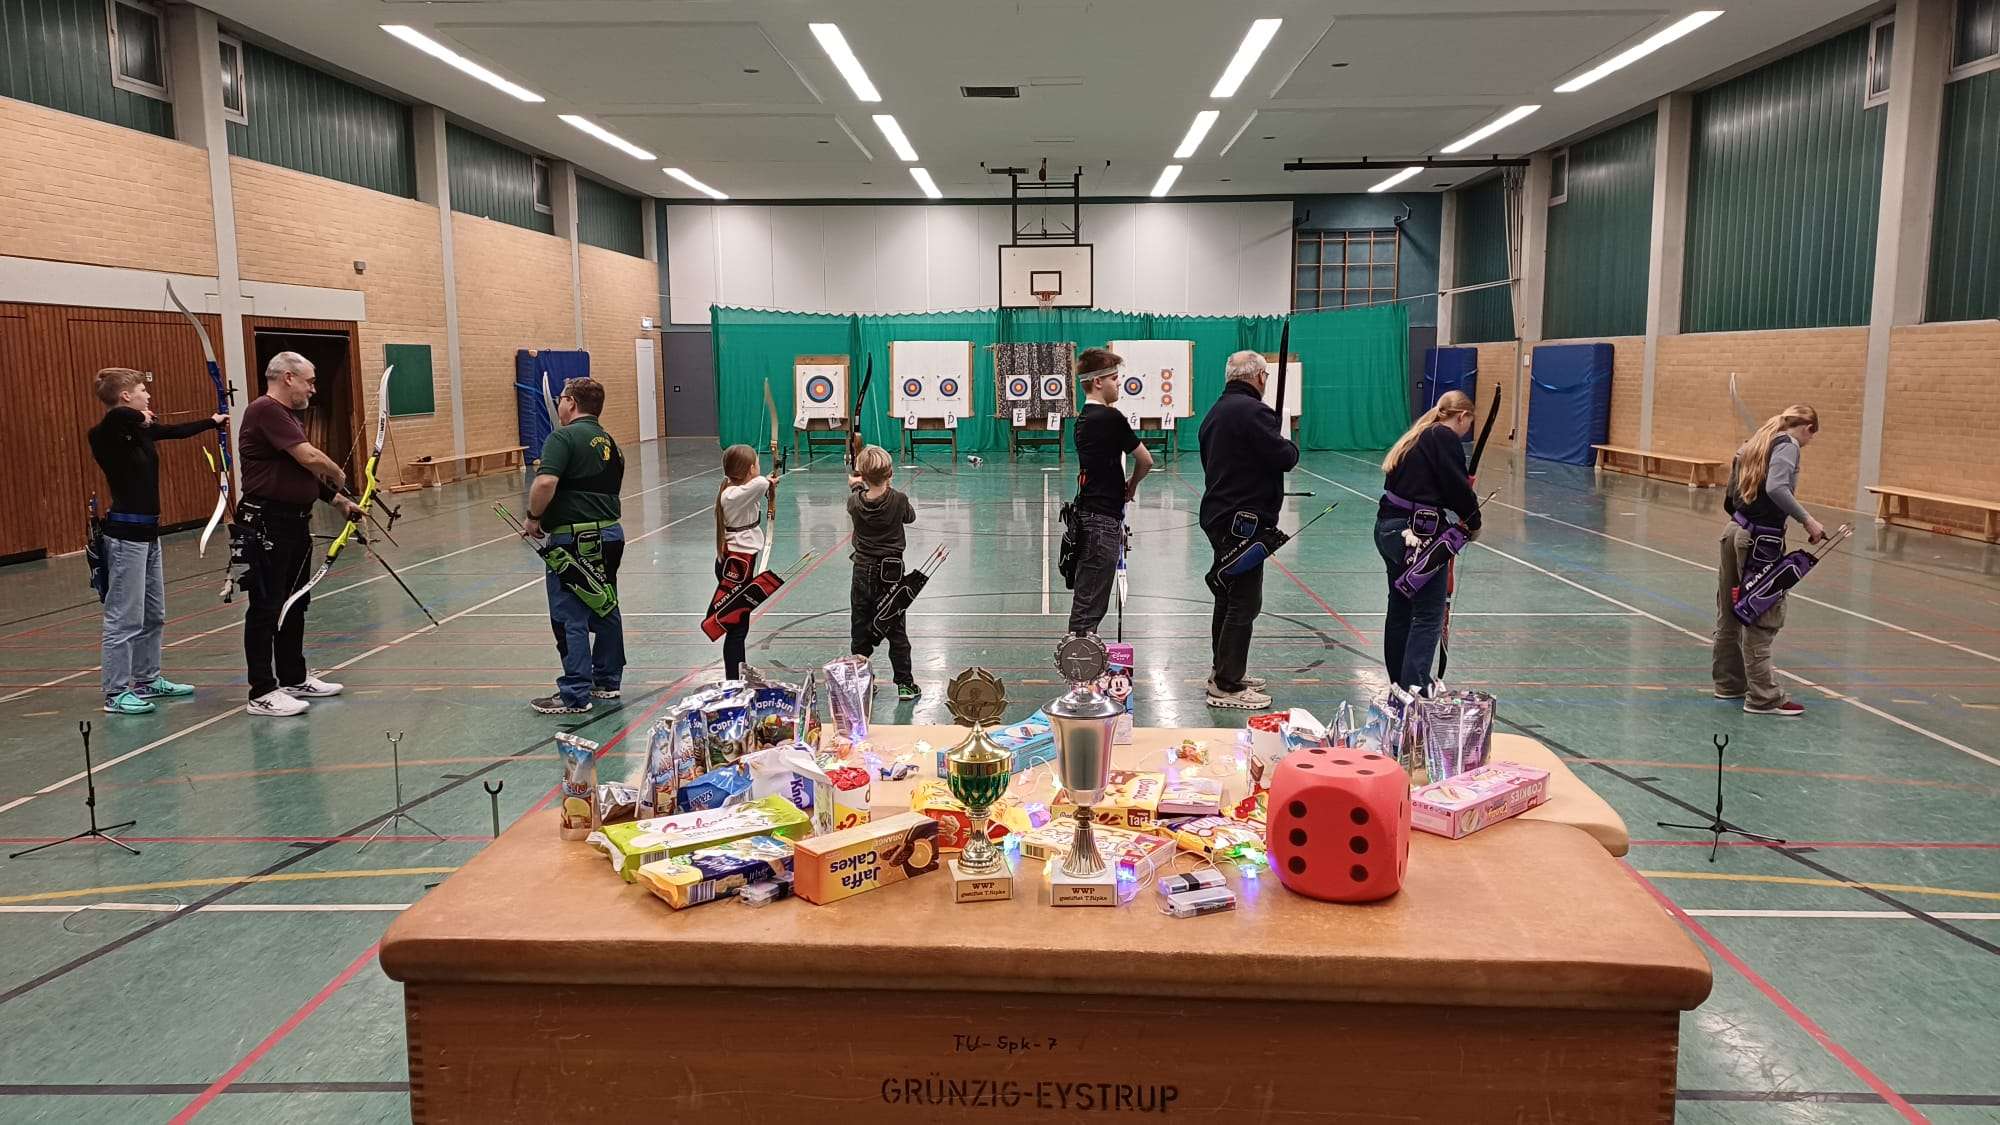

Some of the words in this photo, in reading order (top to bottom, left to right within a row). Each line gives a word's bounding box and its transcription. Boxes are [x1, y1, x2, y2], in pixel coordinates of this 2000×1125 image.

[907, 415, 915, 425] C
[947, 414, 955, 424] D
[1016, 412, 1024, 423] E
[1051, 415, 1058, 427] F
[1745, 563, 1774, 591] AVALON
[1110, 651, 1131, 660] Disney
[754, 698, 794, 713] apri-Sun
[1509, 782, 1543, 803] COOKIES
[830, 850, 878, 873] Cakes
[841, 866, 882, 890] Jaffa
[972, 882, 995, 890] WWP
[1071, 887, 1096, 895] WWP
[880, 1072, 1180, 1113] GRÜNZIG-EYSTRUP
